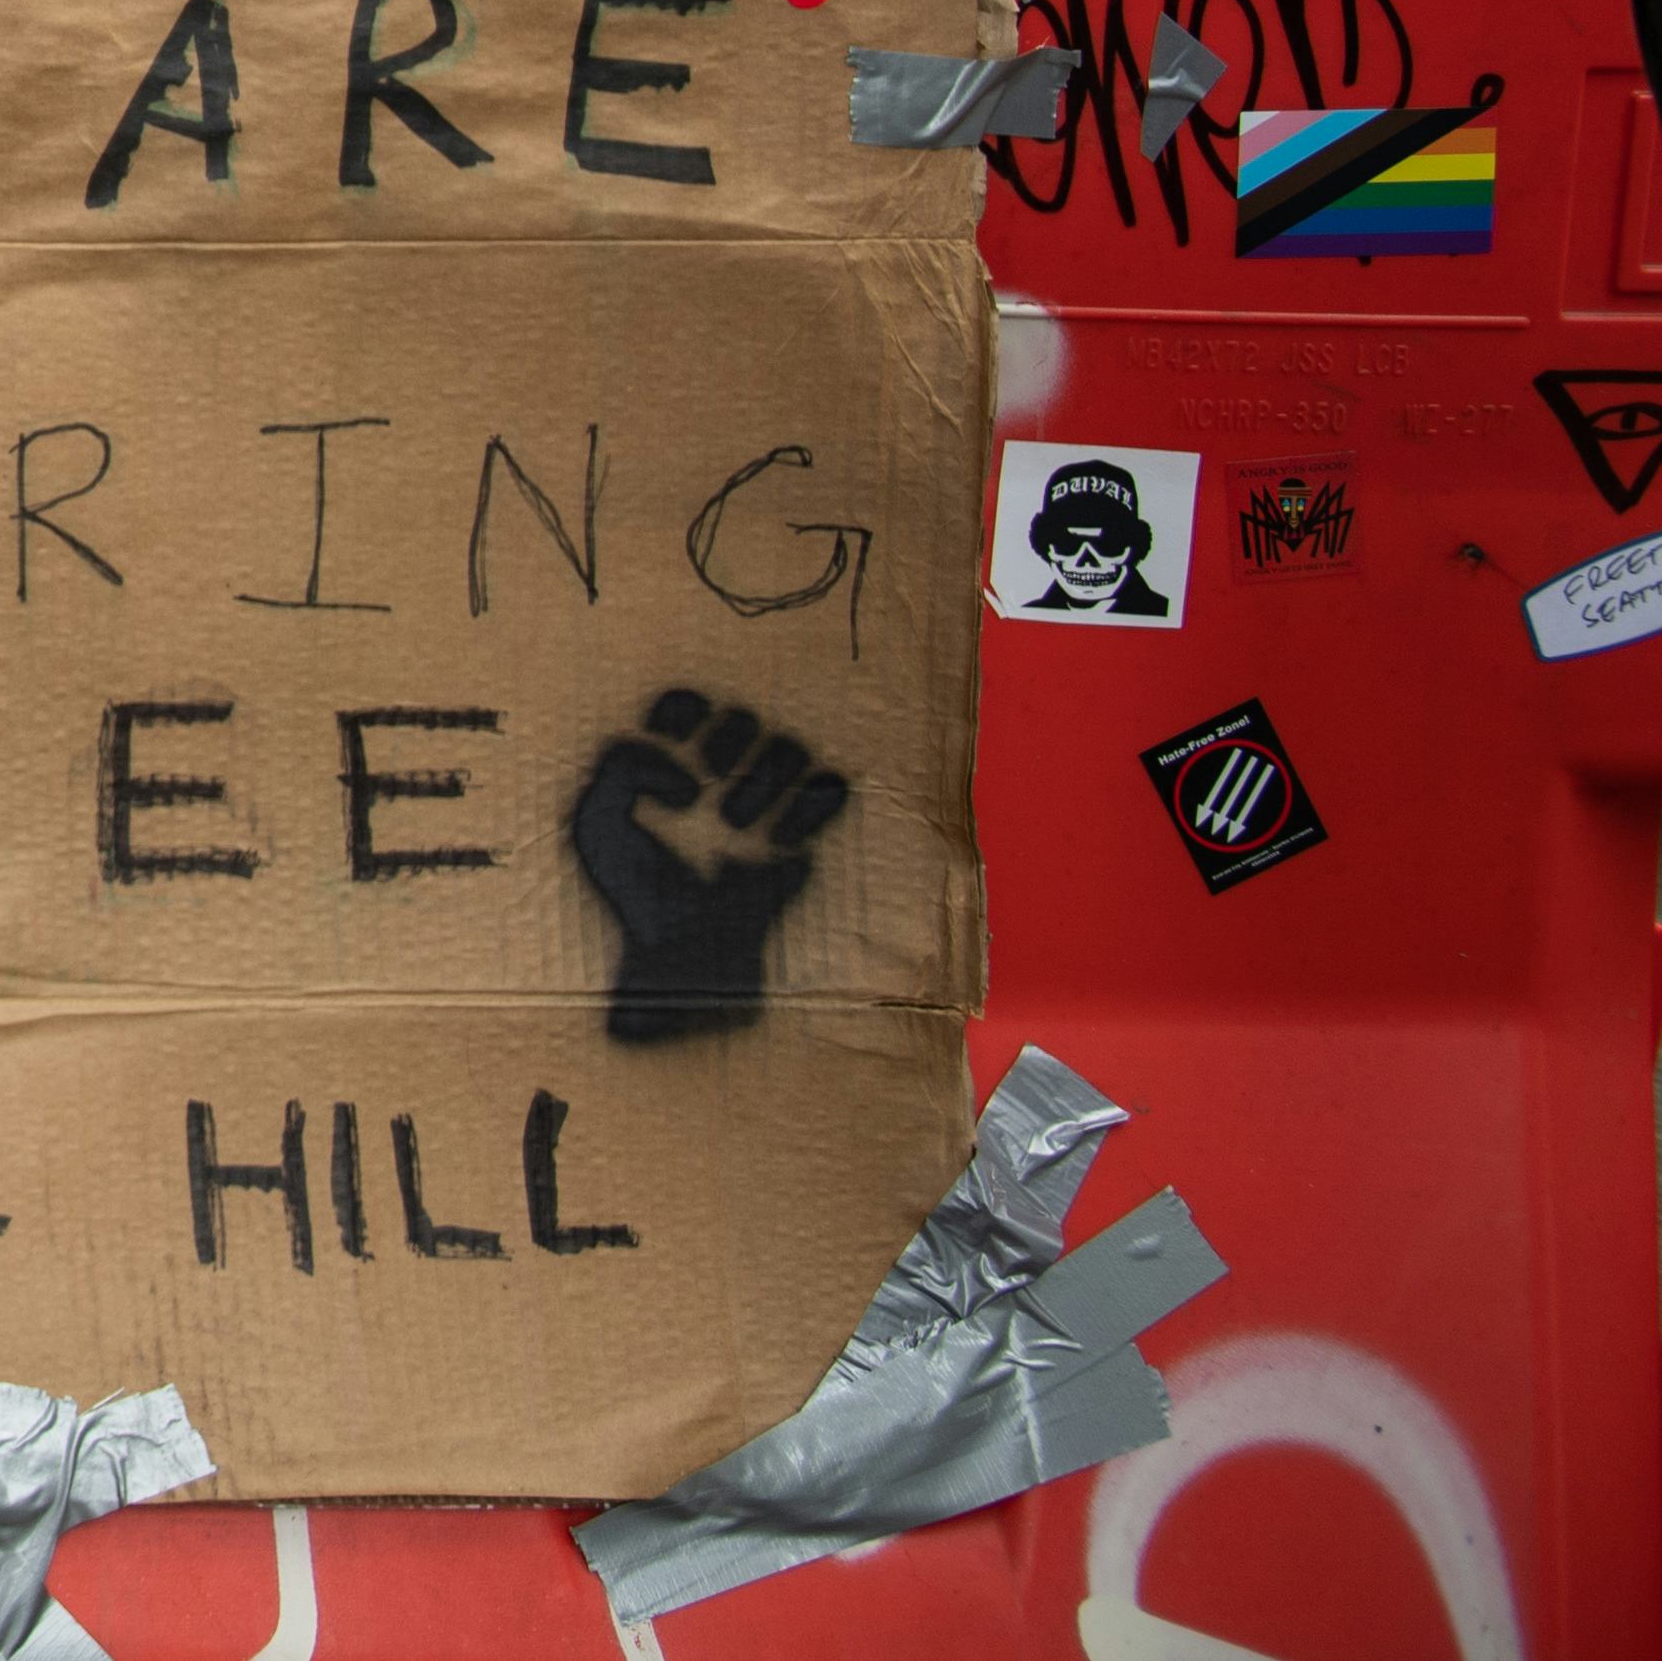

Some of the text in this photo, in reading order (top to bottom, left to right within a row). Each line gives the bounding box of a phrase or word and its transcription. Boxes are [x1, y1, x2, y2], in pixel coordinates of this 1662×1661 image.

[1051, 475, 1133, 511] DUVAL
[1157, 714, 1251, 766] Hate-Free Zone!
[183, 1089, 642, 1276] HILL
